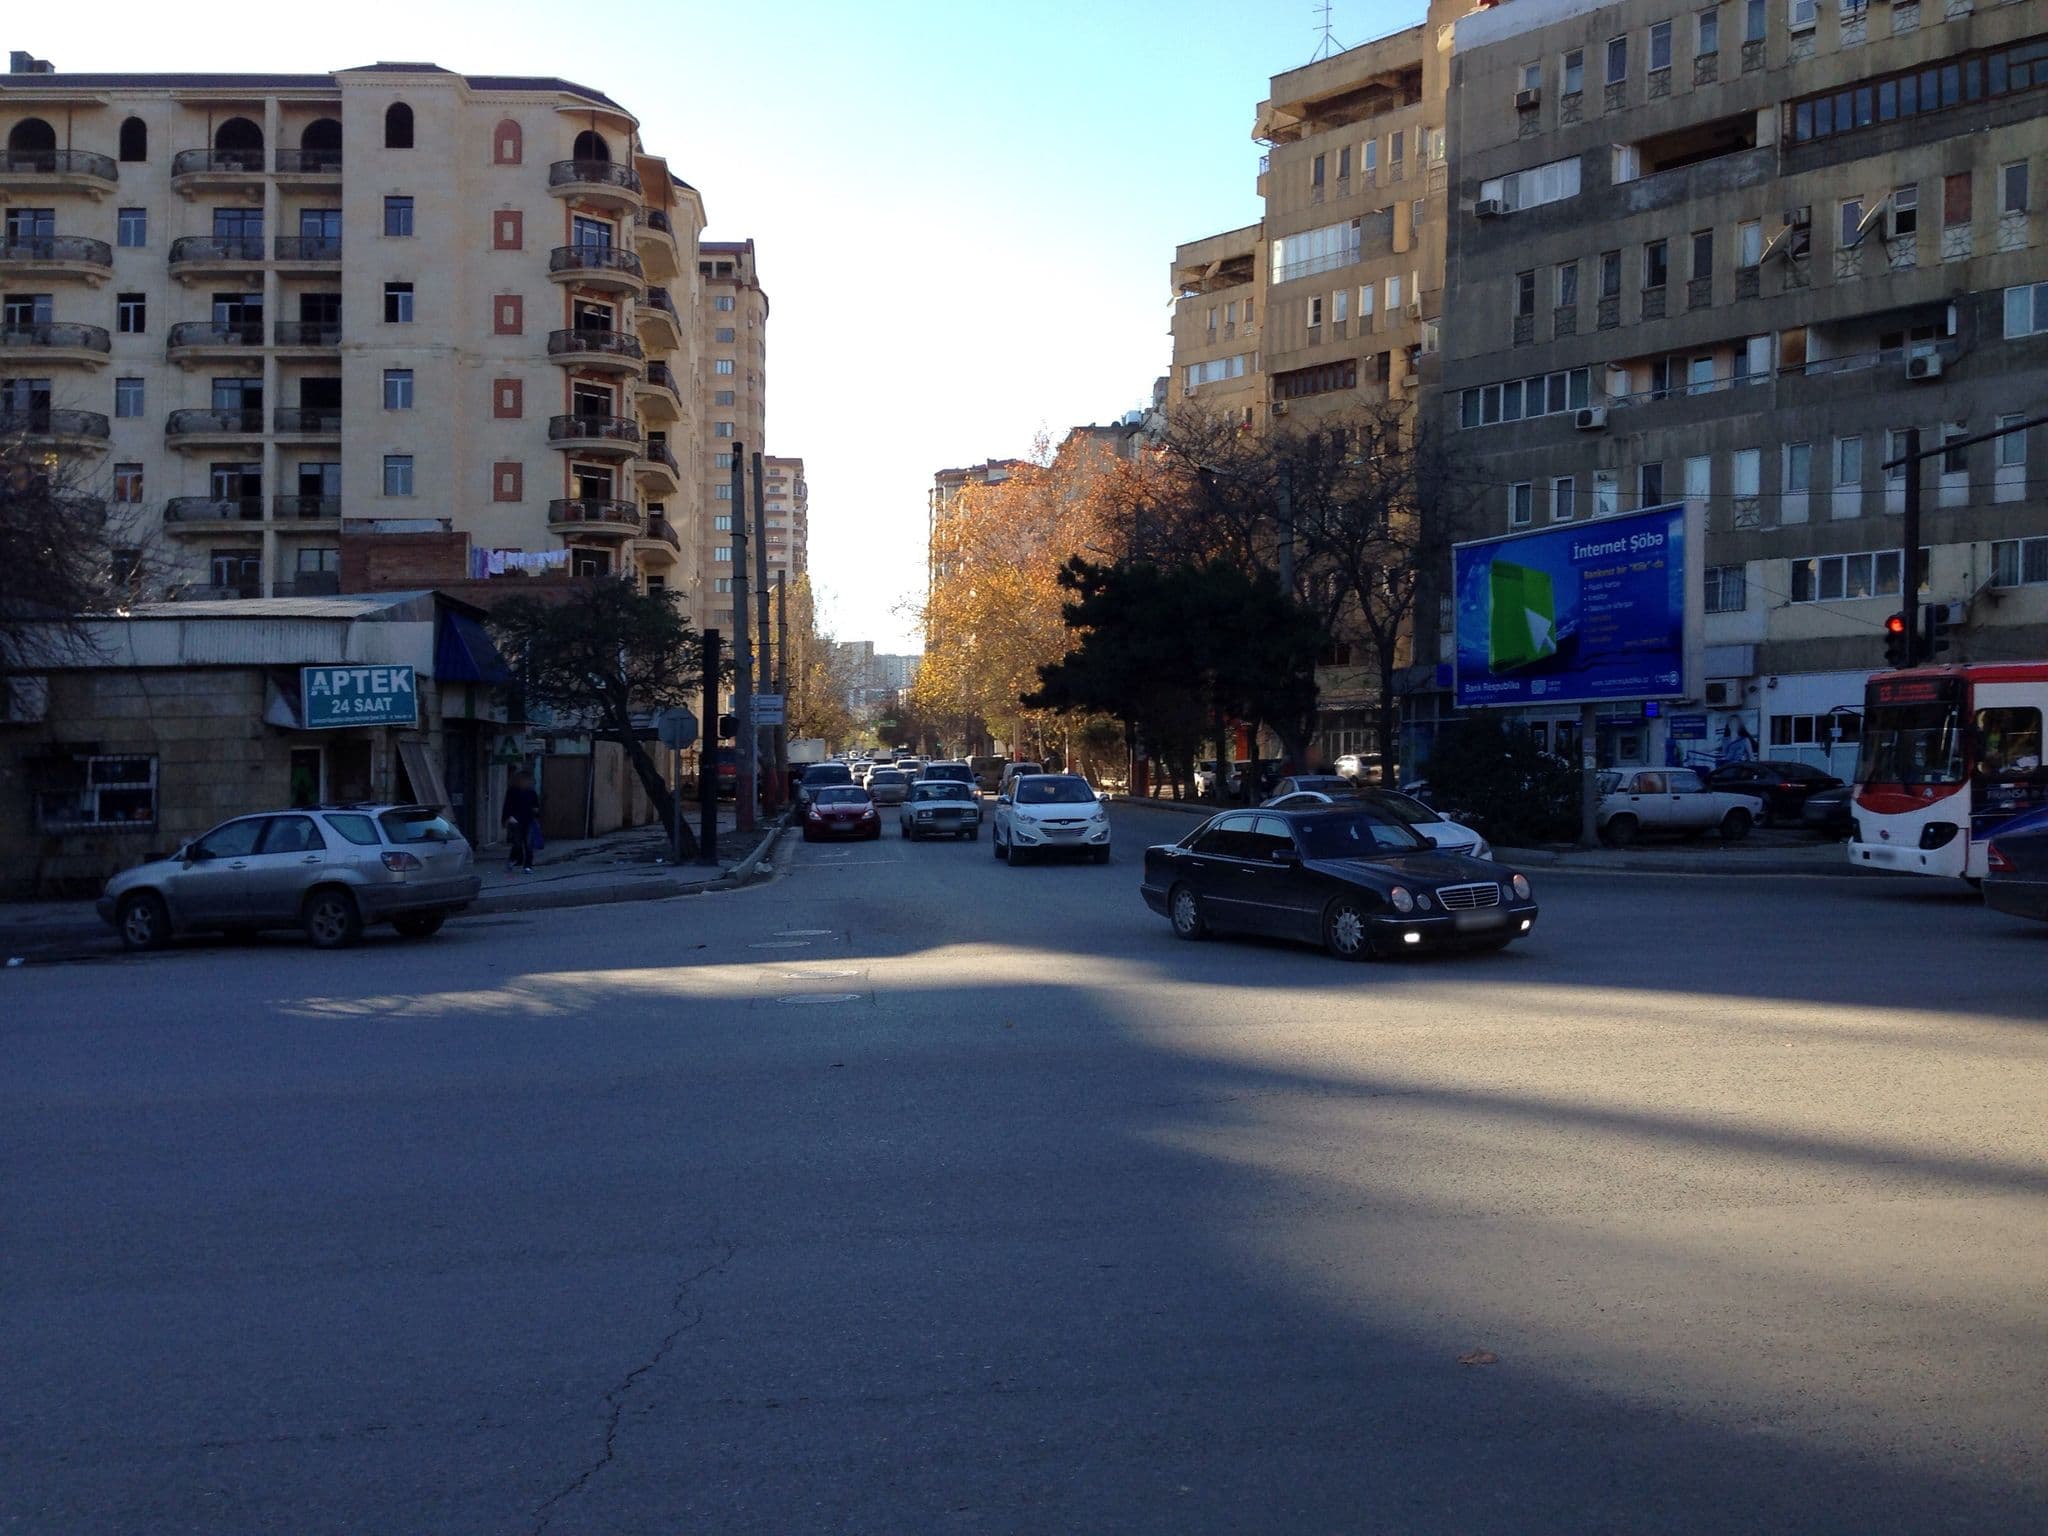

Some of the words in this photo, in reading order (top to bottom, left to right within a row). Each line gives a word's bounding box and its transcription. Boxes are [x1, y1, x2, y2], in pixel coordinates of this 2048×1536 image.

[1630, 532, 1664, 552] Şöbə
[310, 669, 411, 696] APTEK
[1465, 684, 1481, 693] Bank
[1483, 681, 1520, 692] Respublika
[332, 699, 350, 714] 24
[354, 697, 392, 713] SAAT
